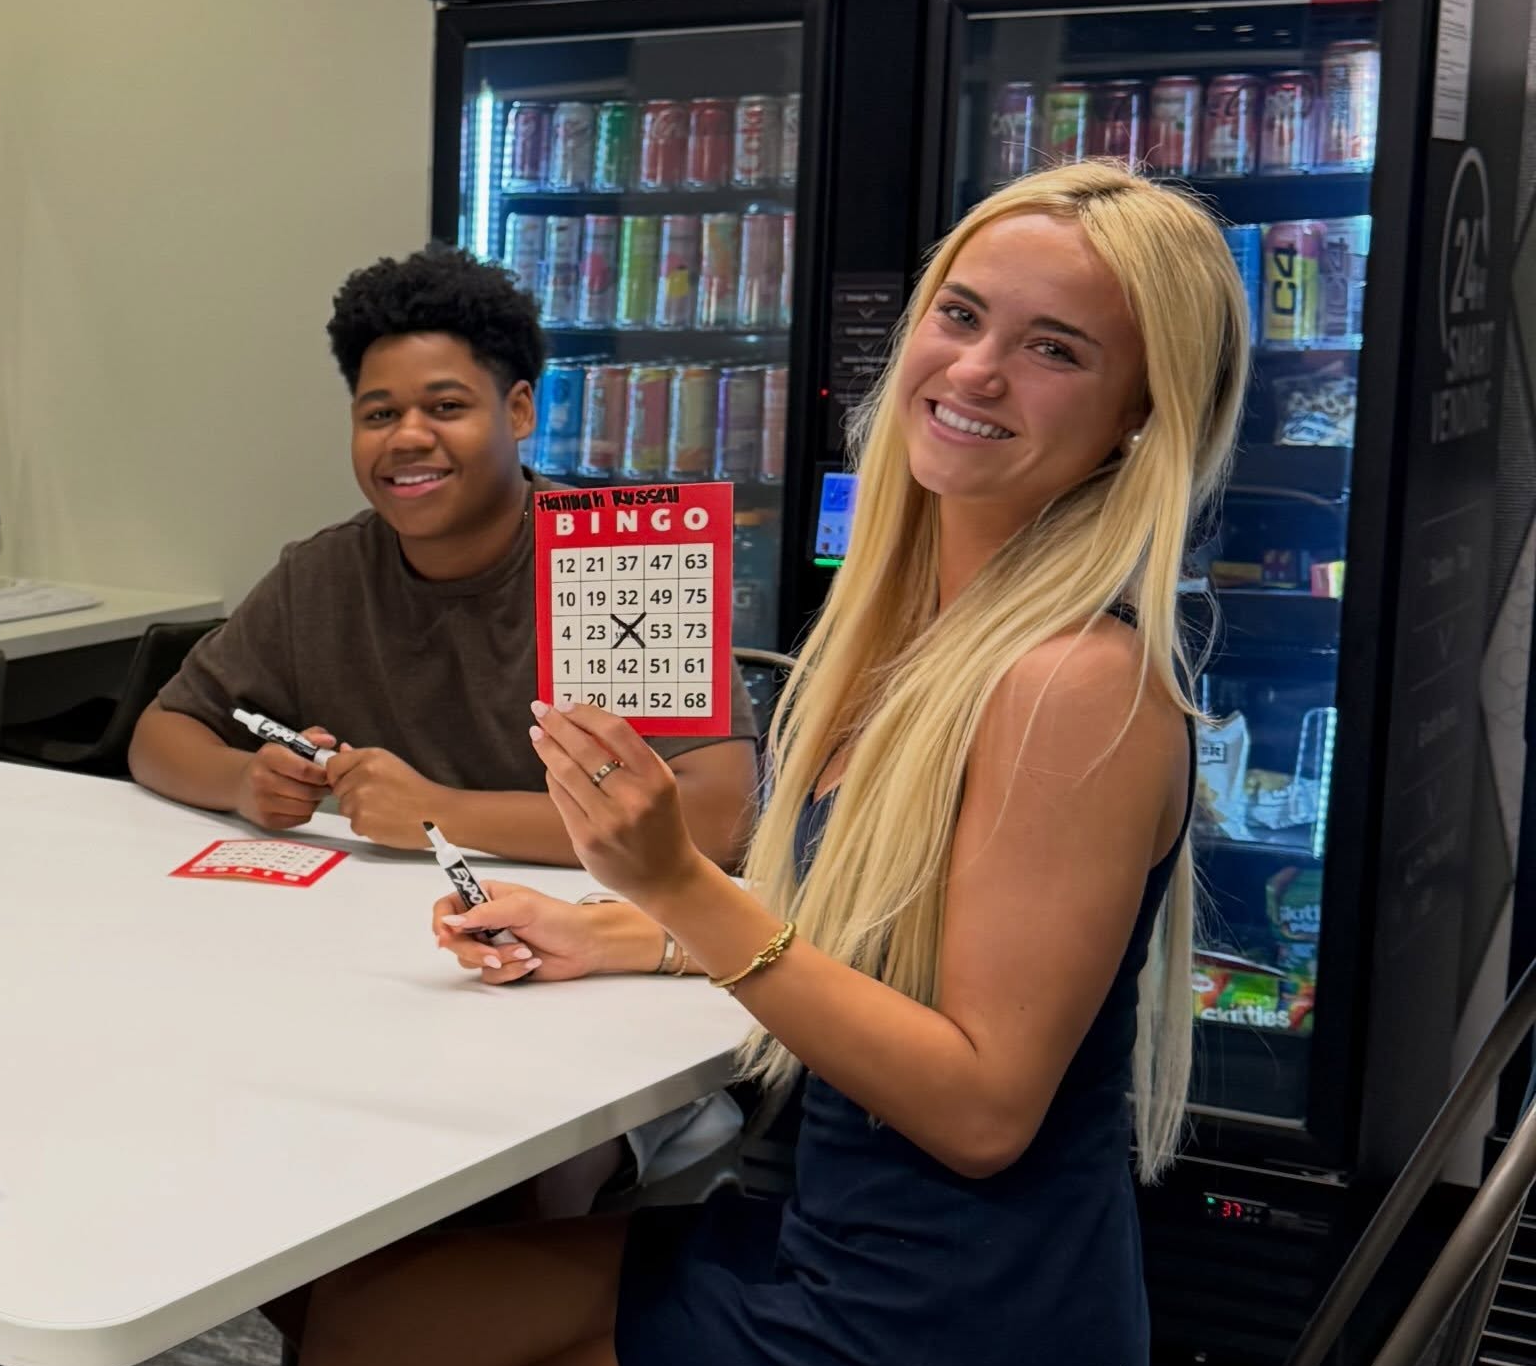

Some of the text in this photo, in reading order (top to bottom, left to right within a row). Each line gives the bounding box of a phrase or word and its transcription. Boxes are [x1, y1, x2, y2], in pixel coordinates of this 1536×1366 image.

[1272, 243, 1297, 316] C4
[556, 507, 709, 535] BINGO
[558, 554, 707, 573] 12 21 37 47 63
[558, 589, 706, 606] 10 19 32 49 75
[562, 626, 571, 640] 4
[587, 625, 605, 640] 23
[651, 624, 671, 639] 53
[684, 623, 706, 638] 73
[564, 659, 704, 674] 1 18 42 51 61
[588, 693, 606, 708] 20
[617, 693, 638, 707] 44
[650, 693, 671, 708] 52
[685, 693, 706, 708] 68
[451, 868, 485, 904] EXPO
[1221, 1201, 1242, 1218] 37
